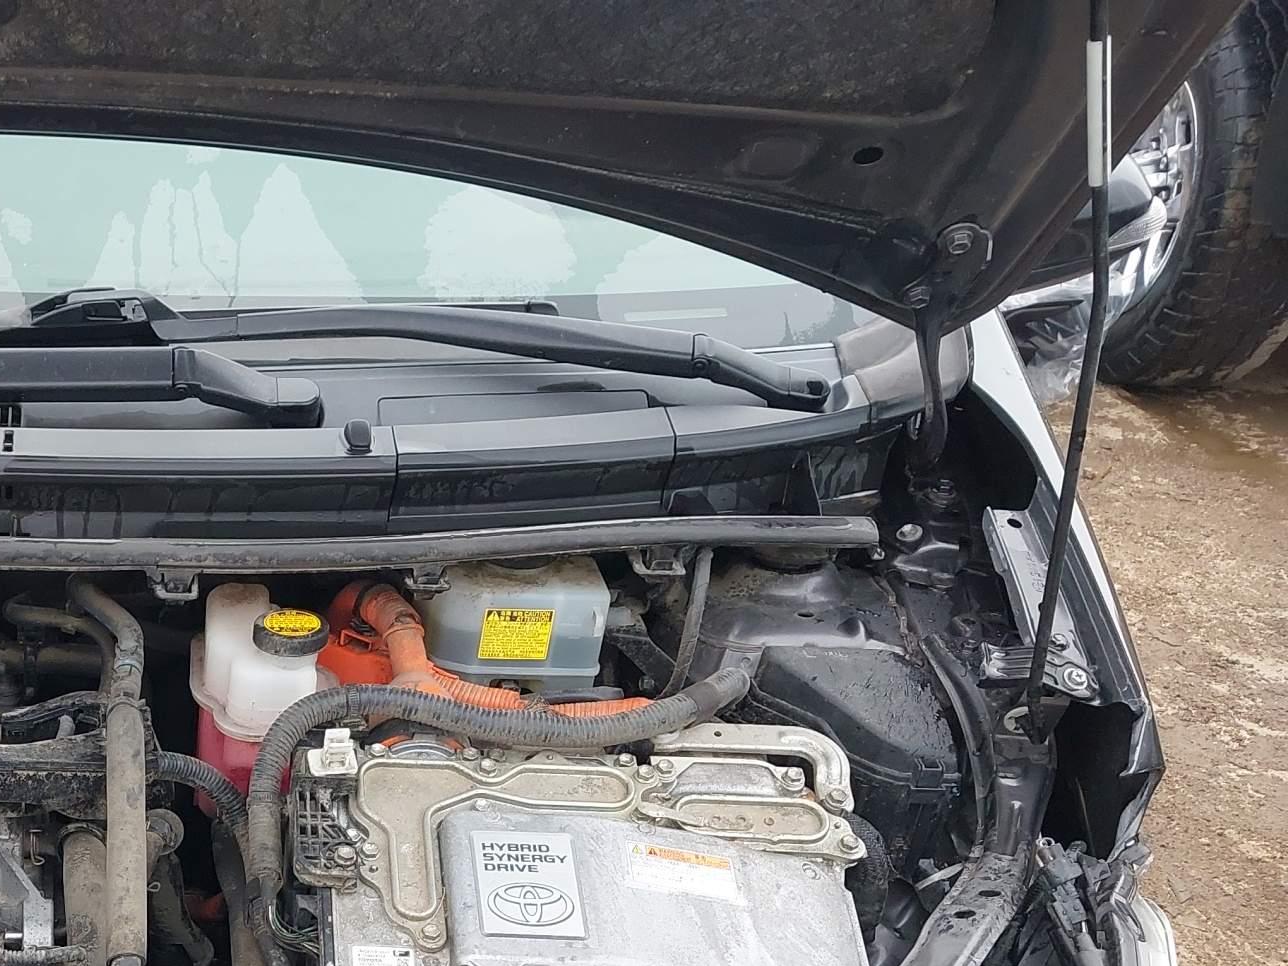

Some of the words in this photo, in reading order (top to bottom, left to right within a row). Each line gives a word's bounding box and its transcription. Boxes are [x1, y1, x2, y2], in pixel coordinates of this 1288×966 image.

[481, 843, 550, 853] HYBRID
[482, 853, 568, 863] SYNERGY
[483, 863, 540, 873] DRIVE
